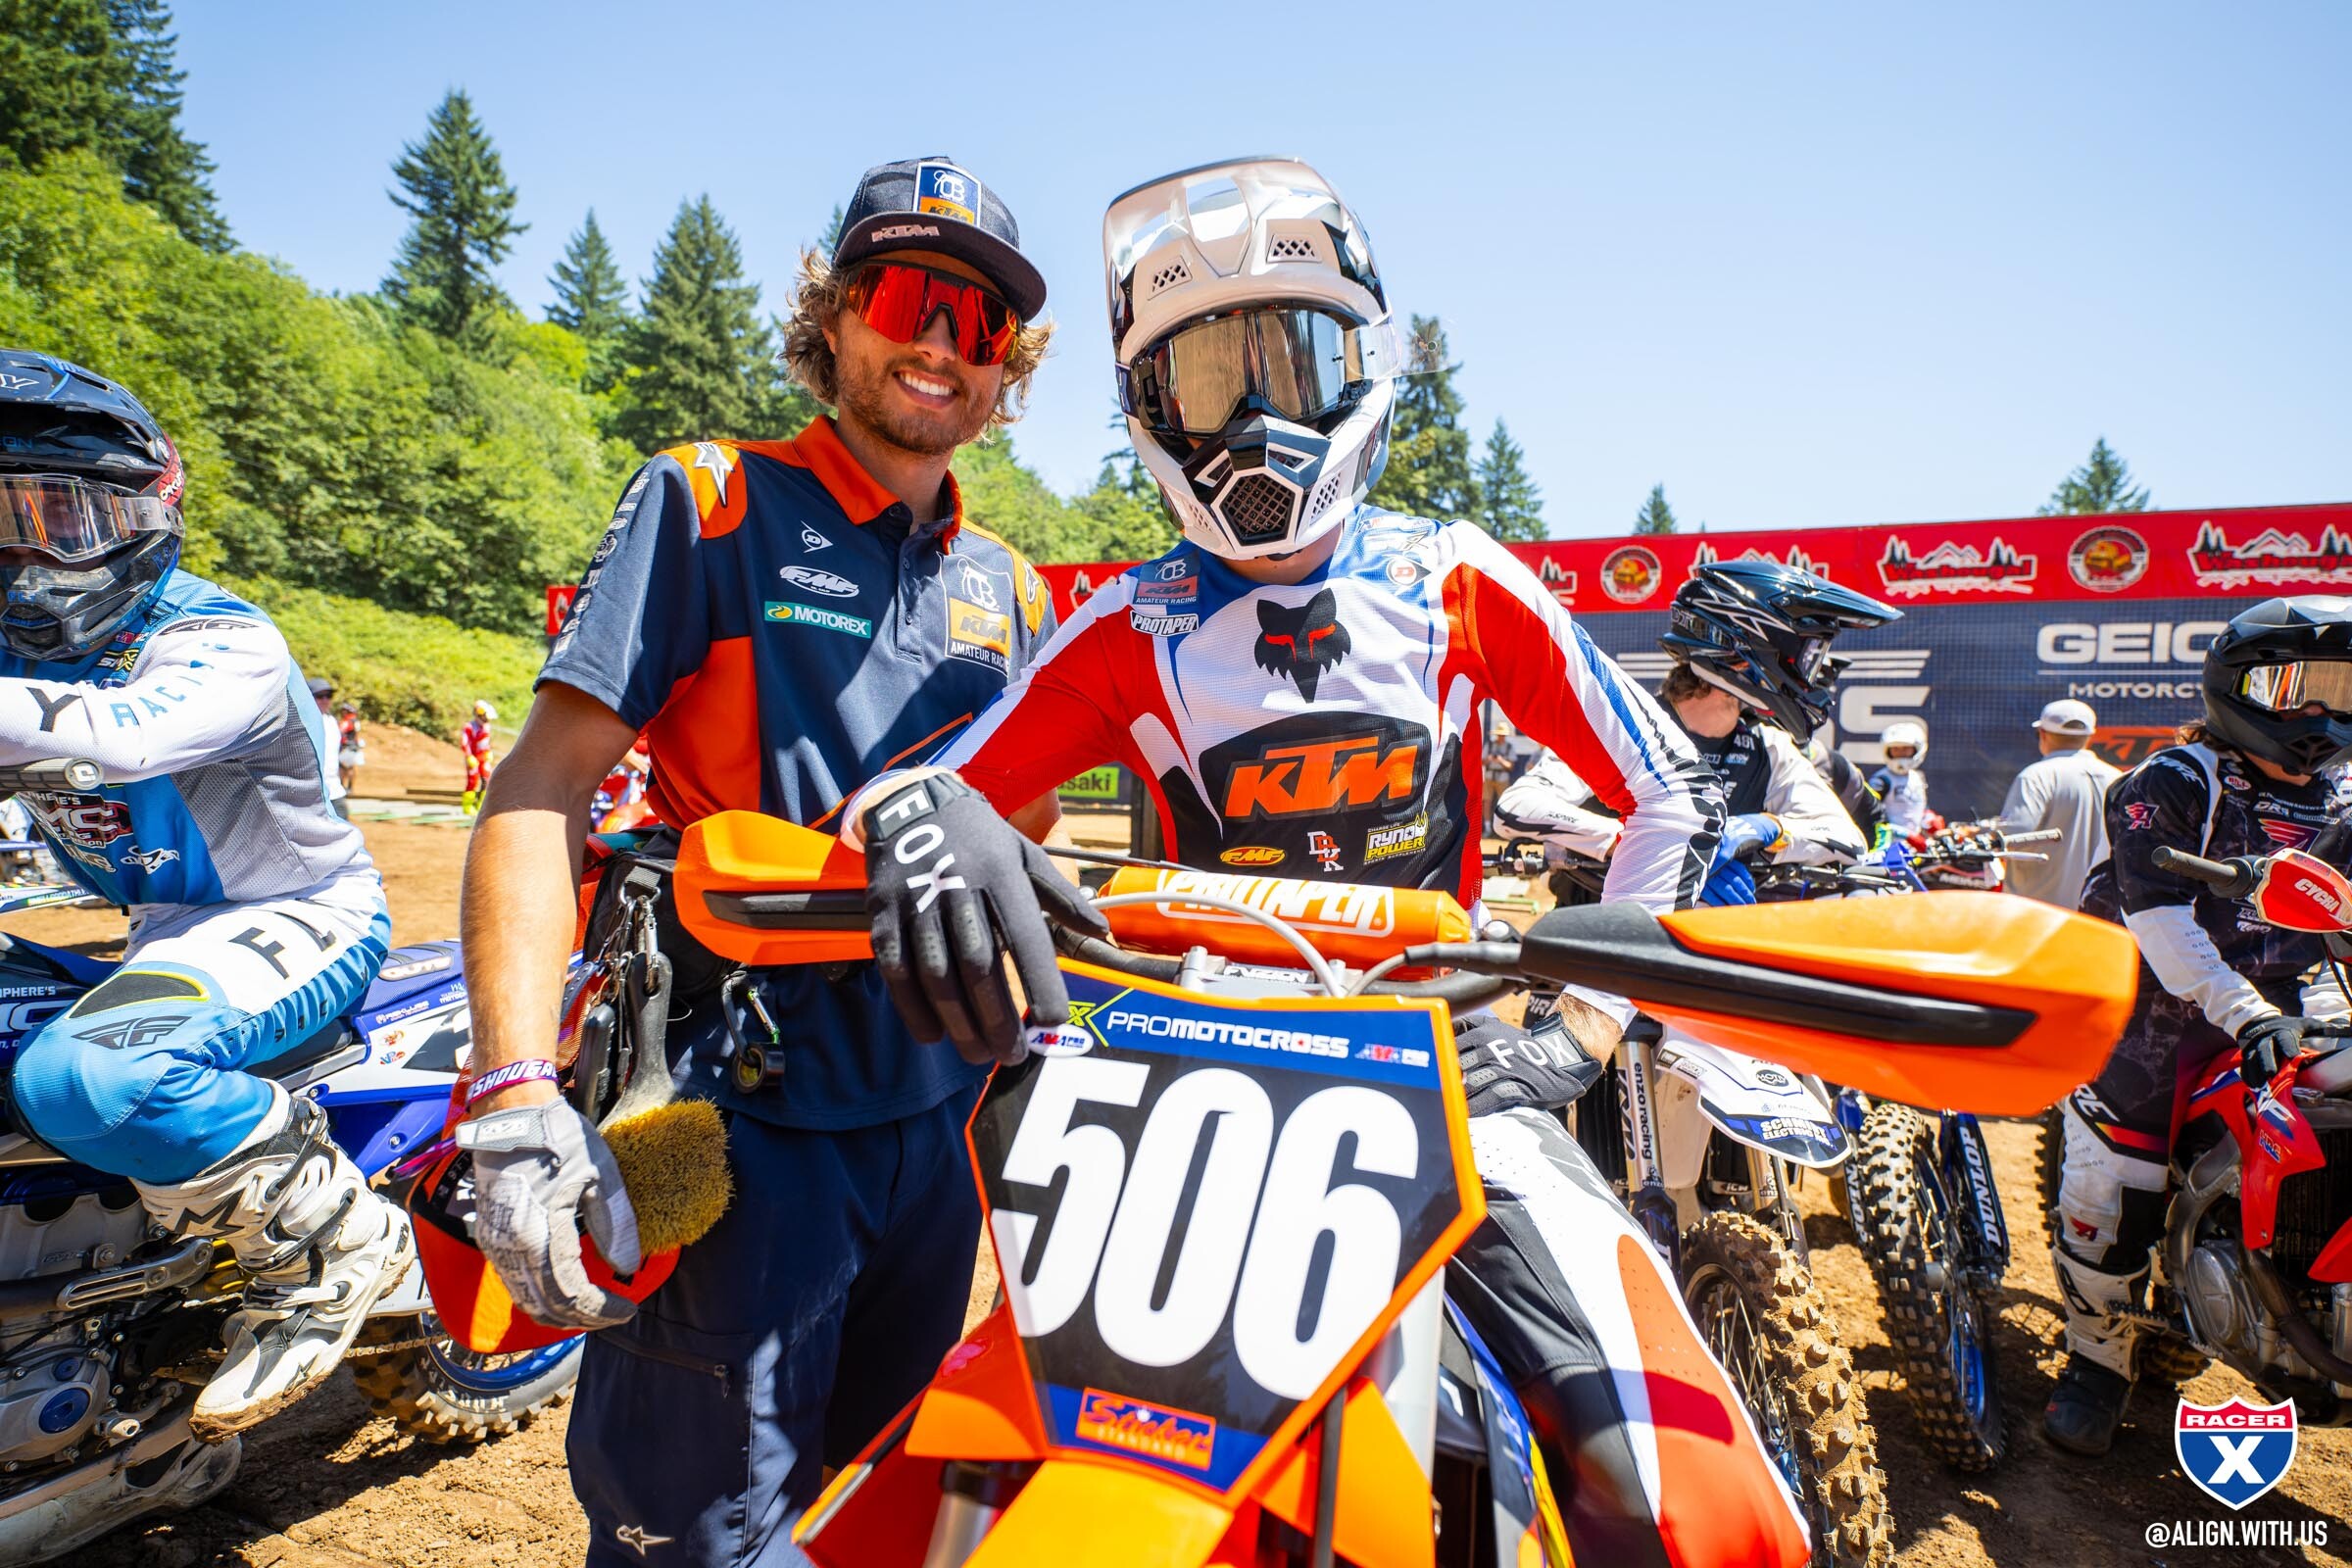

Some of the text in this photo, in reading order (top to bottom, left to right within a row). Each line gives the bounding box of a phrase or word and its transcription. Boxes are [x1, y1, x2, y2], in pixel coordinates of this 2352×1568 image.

[871, 224, 940, 243] KTM
[780, 567, 858, 593] FMF
[1145, 584, 1190, 595] KTM
[795, 606, 868, 636] MOTOREX
[959, 615, 1007, 645] KTM
[1133, 614, 1198, 635] PROTAPER
[951, 642, 1009, 672] AMATEUR RAC
[2037, 621, 2230, 664] GEIC
[2068, 682, 2204, 699] MOTORC
[2092, 736, 2175, 767] KT
[1224, 736, 1418, 818] KTM
[879, 789, 966, 913] FOX
[1367, 836, 1424, 859] POWER
[1369, 825, 1415, 850] RYNO
[1221, 849, 1285, 863] FMF
[1487, 1034, 1576, 1069] FOX
[1634, 1061, 1653, 1160] enzo racing
[1960, 1127, 2002, 1247] DUNLOP
[990, 1055, 1419, 1400] 506
